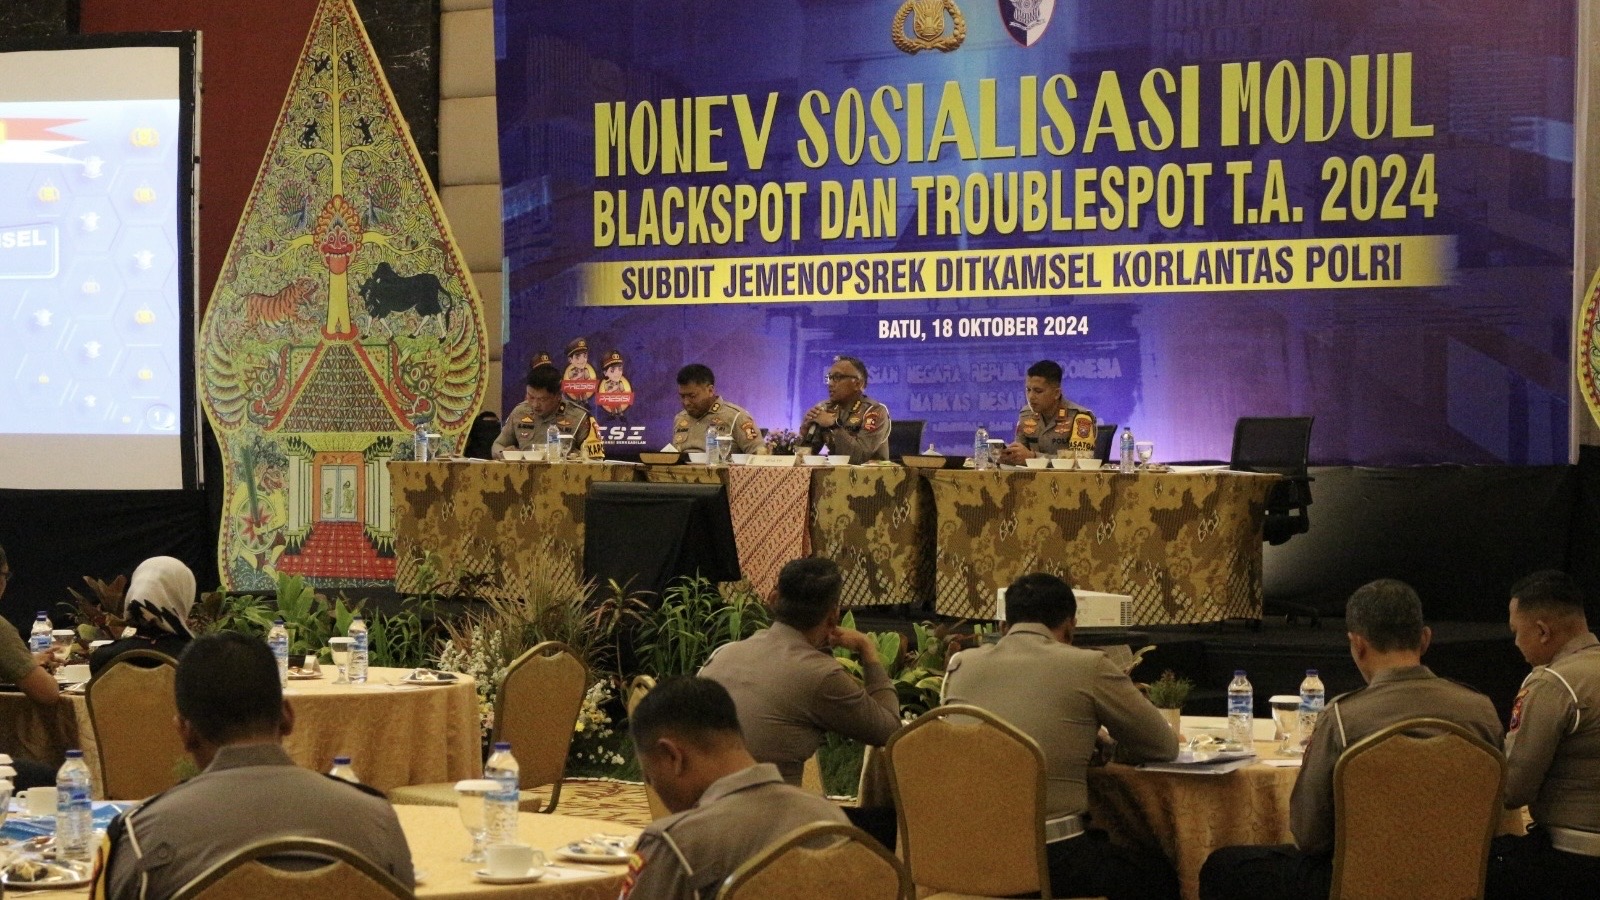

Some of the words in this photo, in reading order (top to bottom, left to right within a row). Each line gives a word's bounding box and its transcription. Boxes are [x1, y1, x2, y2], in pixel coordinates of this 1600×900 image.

[594, 92, 779, 177] MONEV
[797, 65, 1200, 168] SOSIALISASI
[1220, 52, 1434, 147] MODUL
[593, 182, 808, 247] BLACKSPOT
[820, 177, 897, 240] DAN
[911, 162, 1213, 236] TROUBLESPOT
[1226, 159, 1303, 225] T.A.
[1320, 153, 1438, 221] 2024
[621, 264, 714, 301] SUBDIT
[723, 258, 926, 297] JEMENOPSREK
[936, 252, 1102, 292] DITKAMSEL
[1113, 247, 1293, 287] KORLANTAS
[1306, 244, 1402, 282] POLRI
[878, 318, 926, 342] BATU,
[932, 318, 953, 338] 18
[958, 316, 1039, 338] OKTOBER
[1043, 315, 1089, 336] 2024
[564, 382, 596, 391] PRESISI
[598, 395, 631, 403] PRESISI
[910, 392, 970, 412] MARKAS
